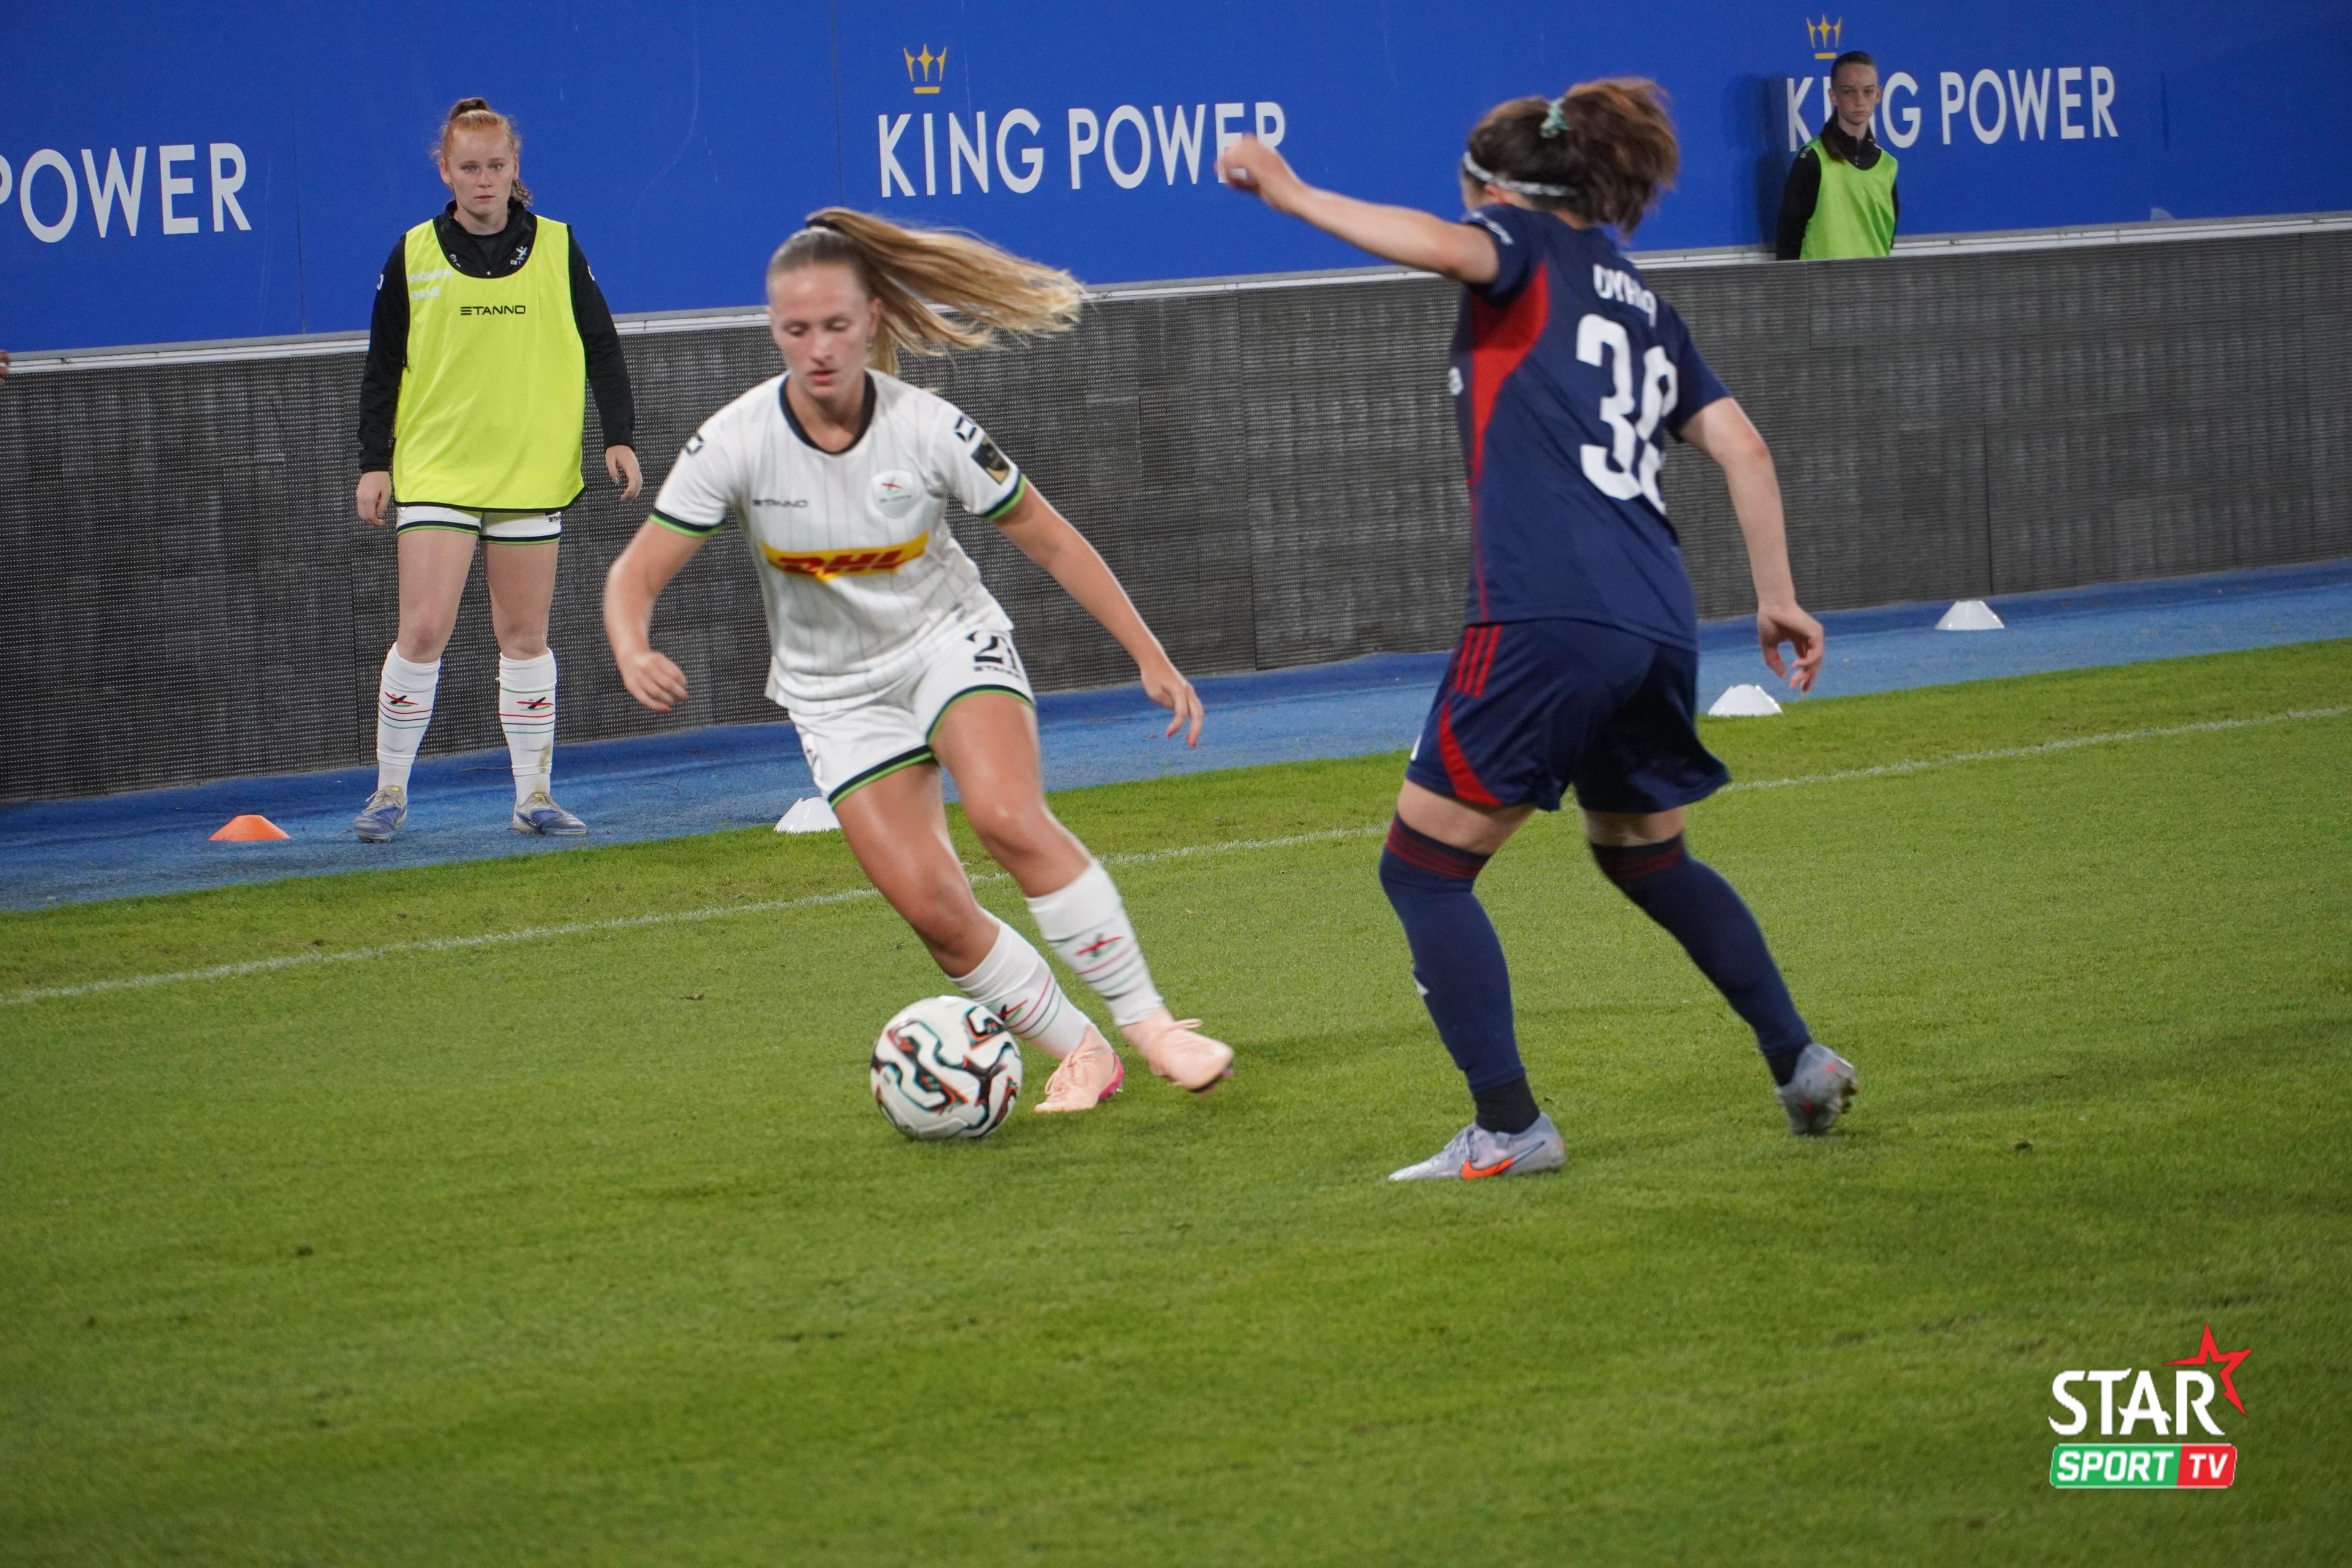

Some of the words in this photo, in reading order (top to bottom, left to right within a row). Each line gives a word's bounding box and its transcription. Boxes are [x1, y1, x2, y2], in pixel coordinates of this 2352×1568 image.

[1786, 72, 1921, 152] KIG
[1939, 66, 2119, 145] POWER
[878, 108, 1044, 197] KING
[779, 549, 903, 576] DHL
